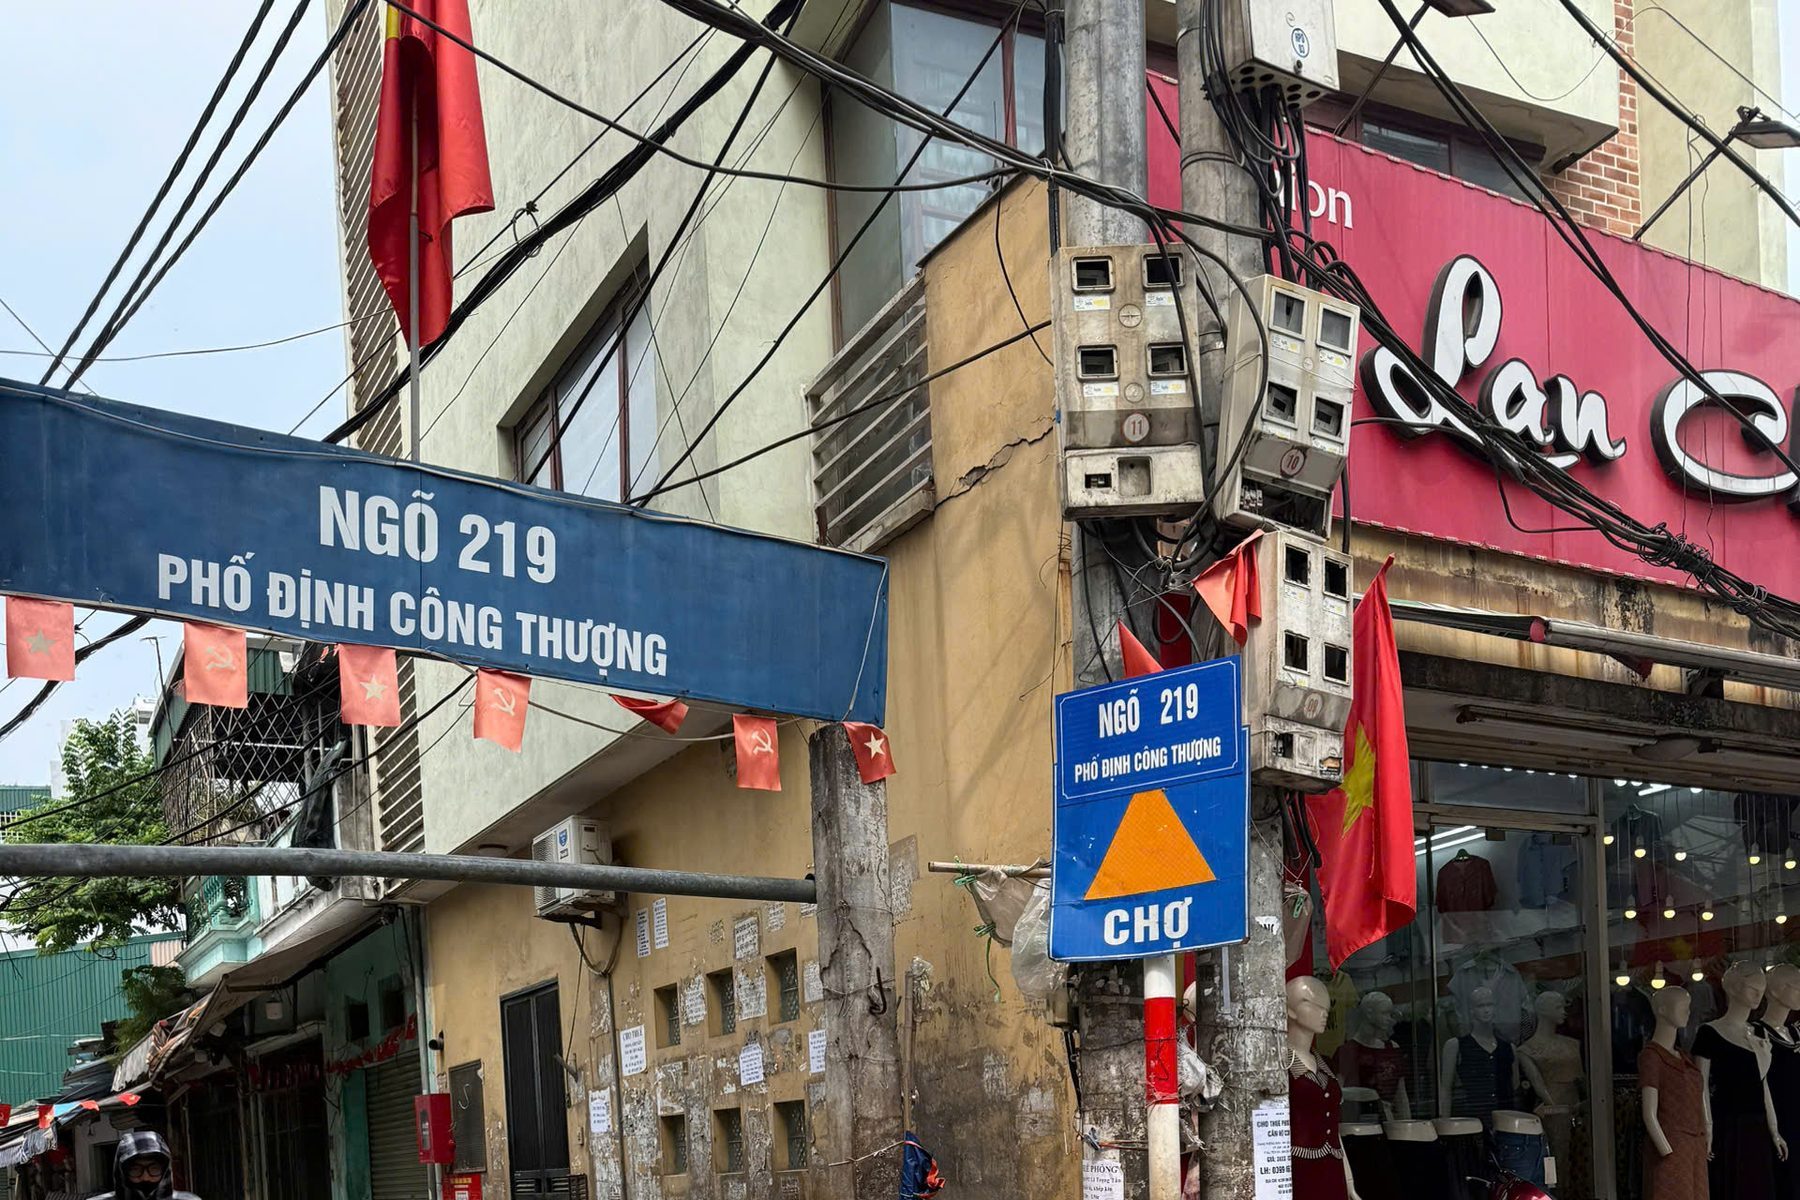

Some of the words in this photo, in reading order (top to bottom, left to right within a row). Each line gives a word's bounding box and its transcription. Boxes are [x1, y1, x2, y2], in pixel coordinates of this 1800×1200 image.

[1652, 369, 1800, 500] C
[319, 485, 439, 563] NGÕ
[458, 514, 557, 584] 219
[158, 552, 256, 612] PHỐ
[389, 587, 502, 650] CÔNG
[515, 612, 667, 677] THƯỢNG
[1099, 688, 1140, 738] NGÕ
[1160, 683, 1198, 725] 219
[1074, 753, 1100, 783] PHỐ
[1102, 754, 1131, 781] ĐỊNH
[1134, 745, 1168, 772] CÔNG
[1171, 736, 1221, 766] THƯỢNG
[1104, 897, 1193, 948] CHỢ
